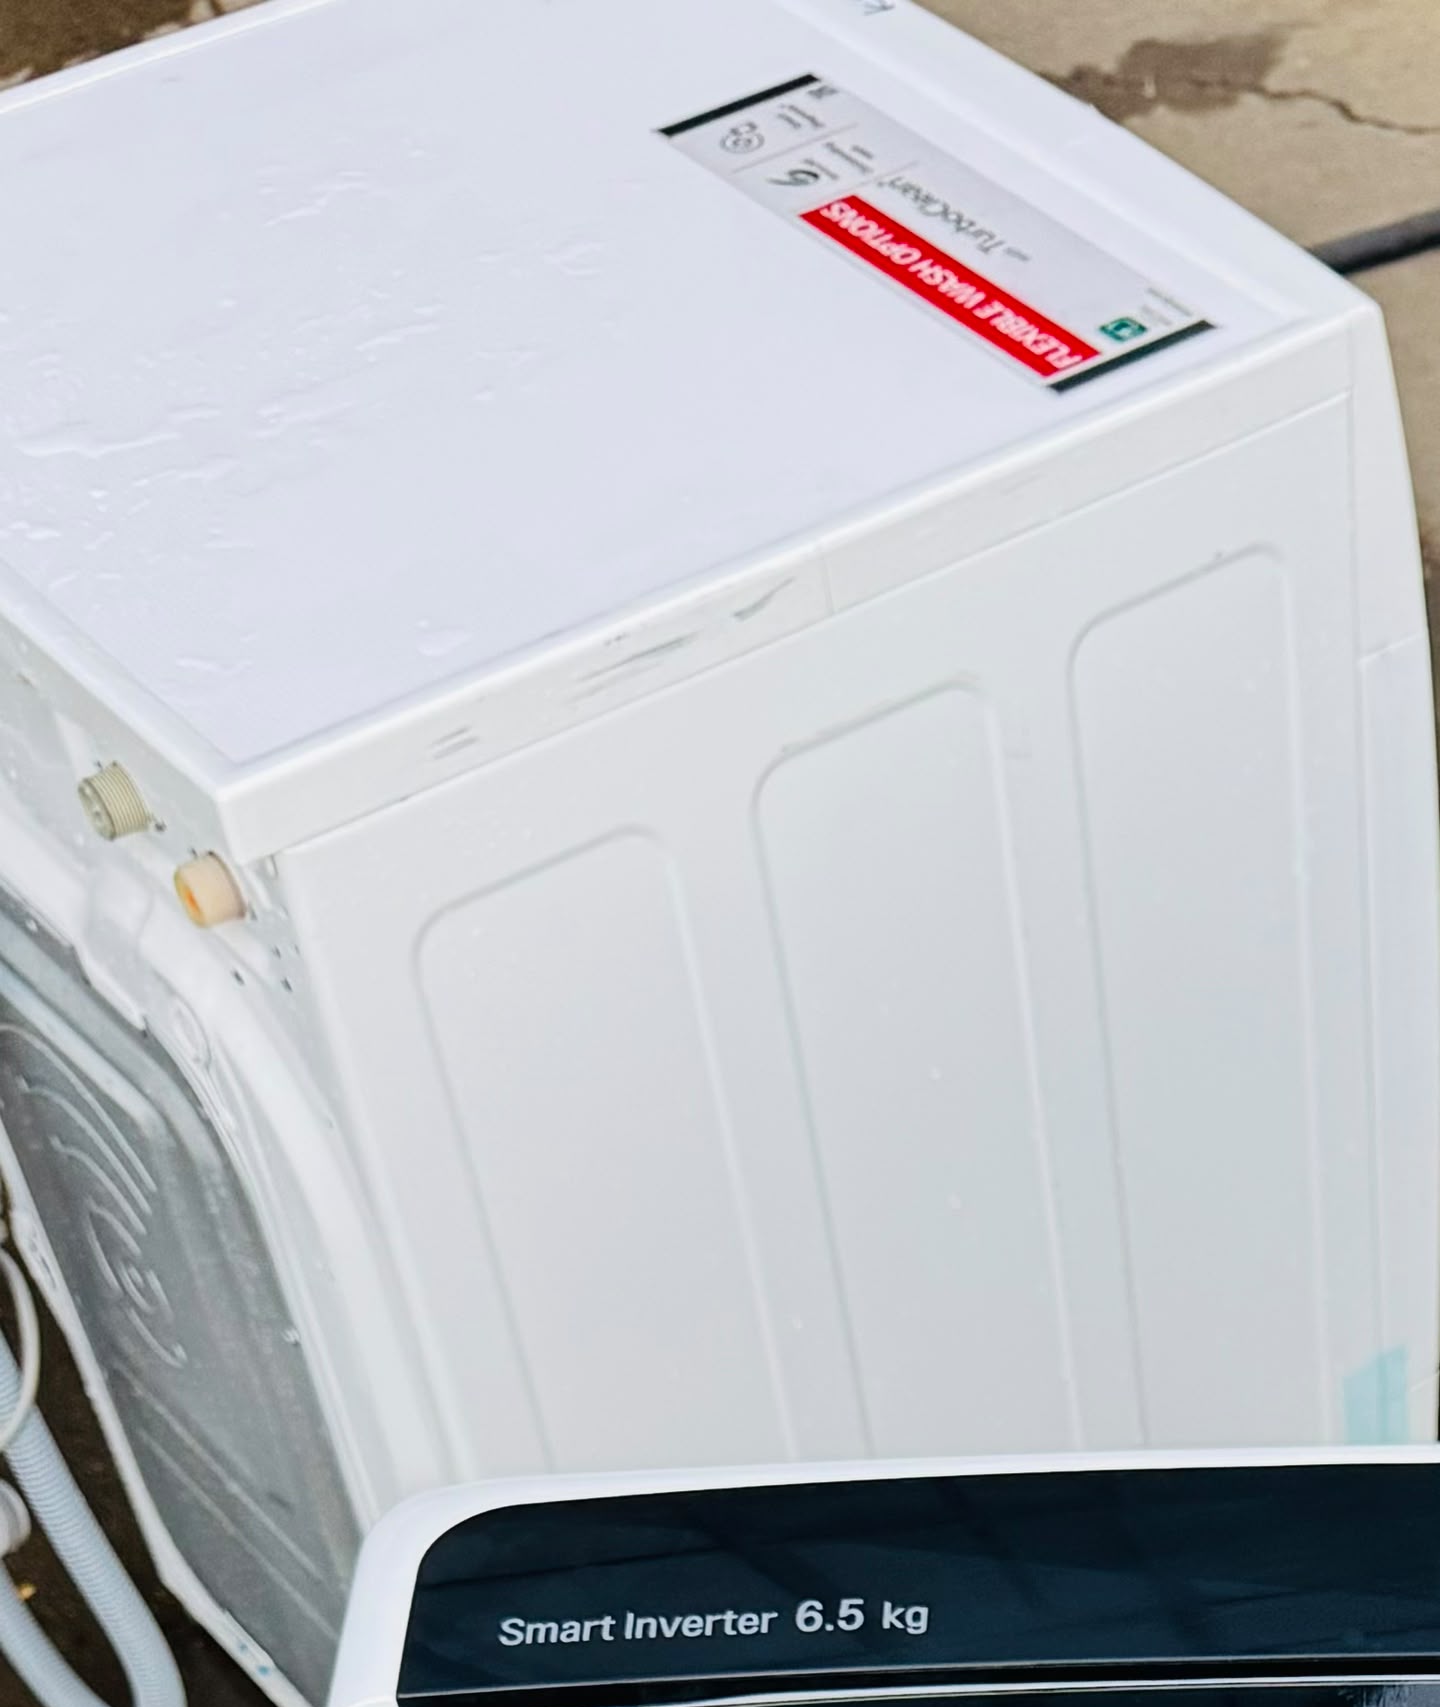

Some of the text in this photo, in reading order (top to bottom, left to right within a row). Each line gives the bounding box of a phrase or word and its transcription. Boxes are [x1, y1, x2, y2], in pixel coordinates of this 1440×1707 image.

[819, 201, 922, 265] OPTIONS
[908, 259, 986, 309] WASH
[972, 300, 1083, 369] FLEXIBLE
[498, 1598, 930, 1647] Smart Inverter 6.5 kg
